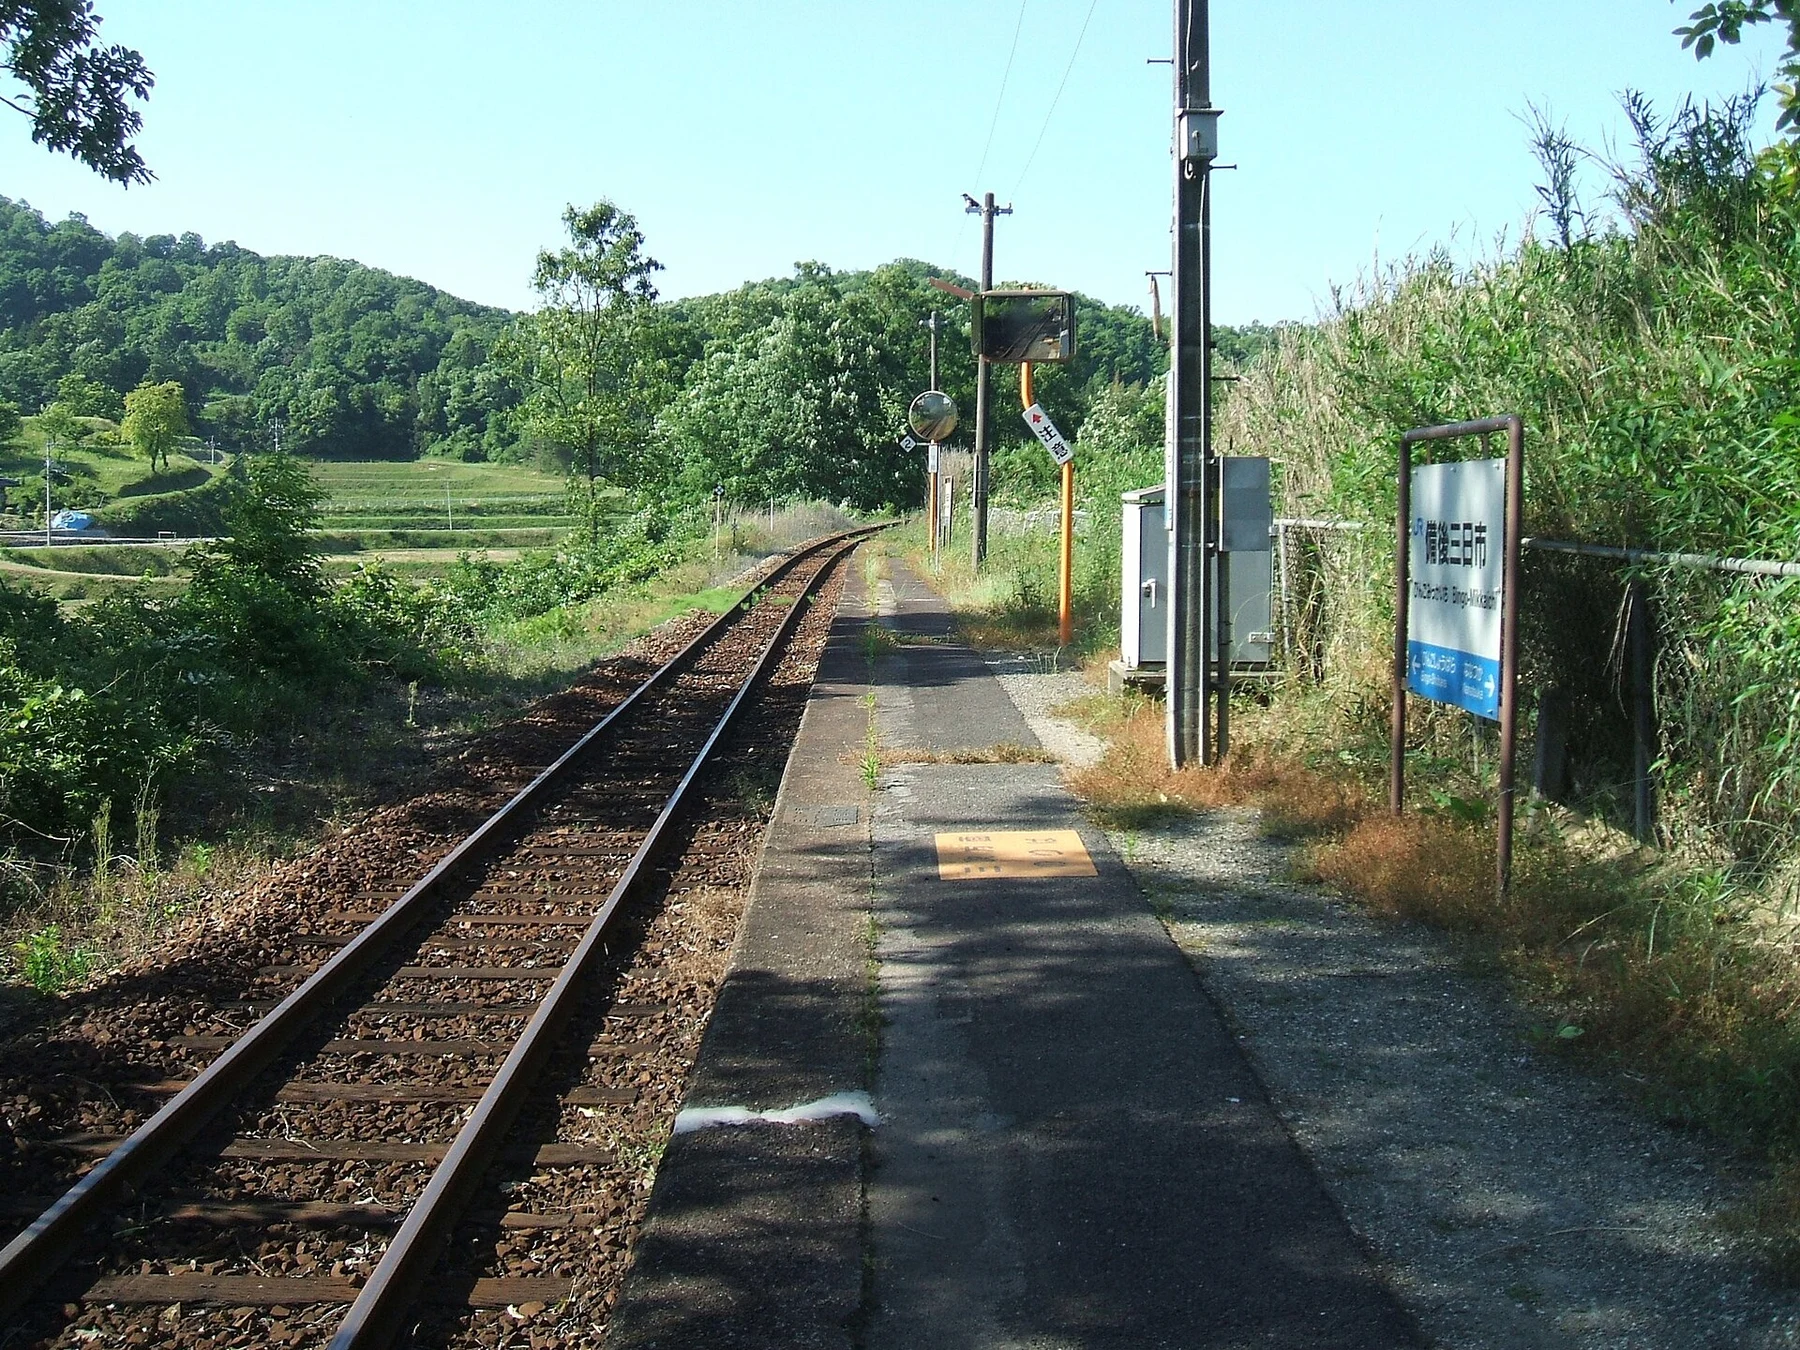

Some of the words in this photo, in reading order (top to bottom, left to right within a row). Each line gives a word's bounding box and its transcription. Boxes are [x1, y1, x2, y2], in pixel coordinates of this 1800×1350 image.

[904, 439, 912, 449] 2
[1039, 425, 1069, 459] 注意
[1414, 517, 1424, 536] JR
[1426, 520, 1487, 569] 備後三日市
